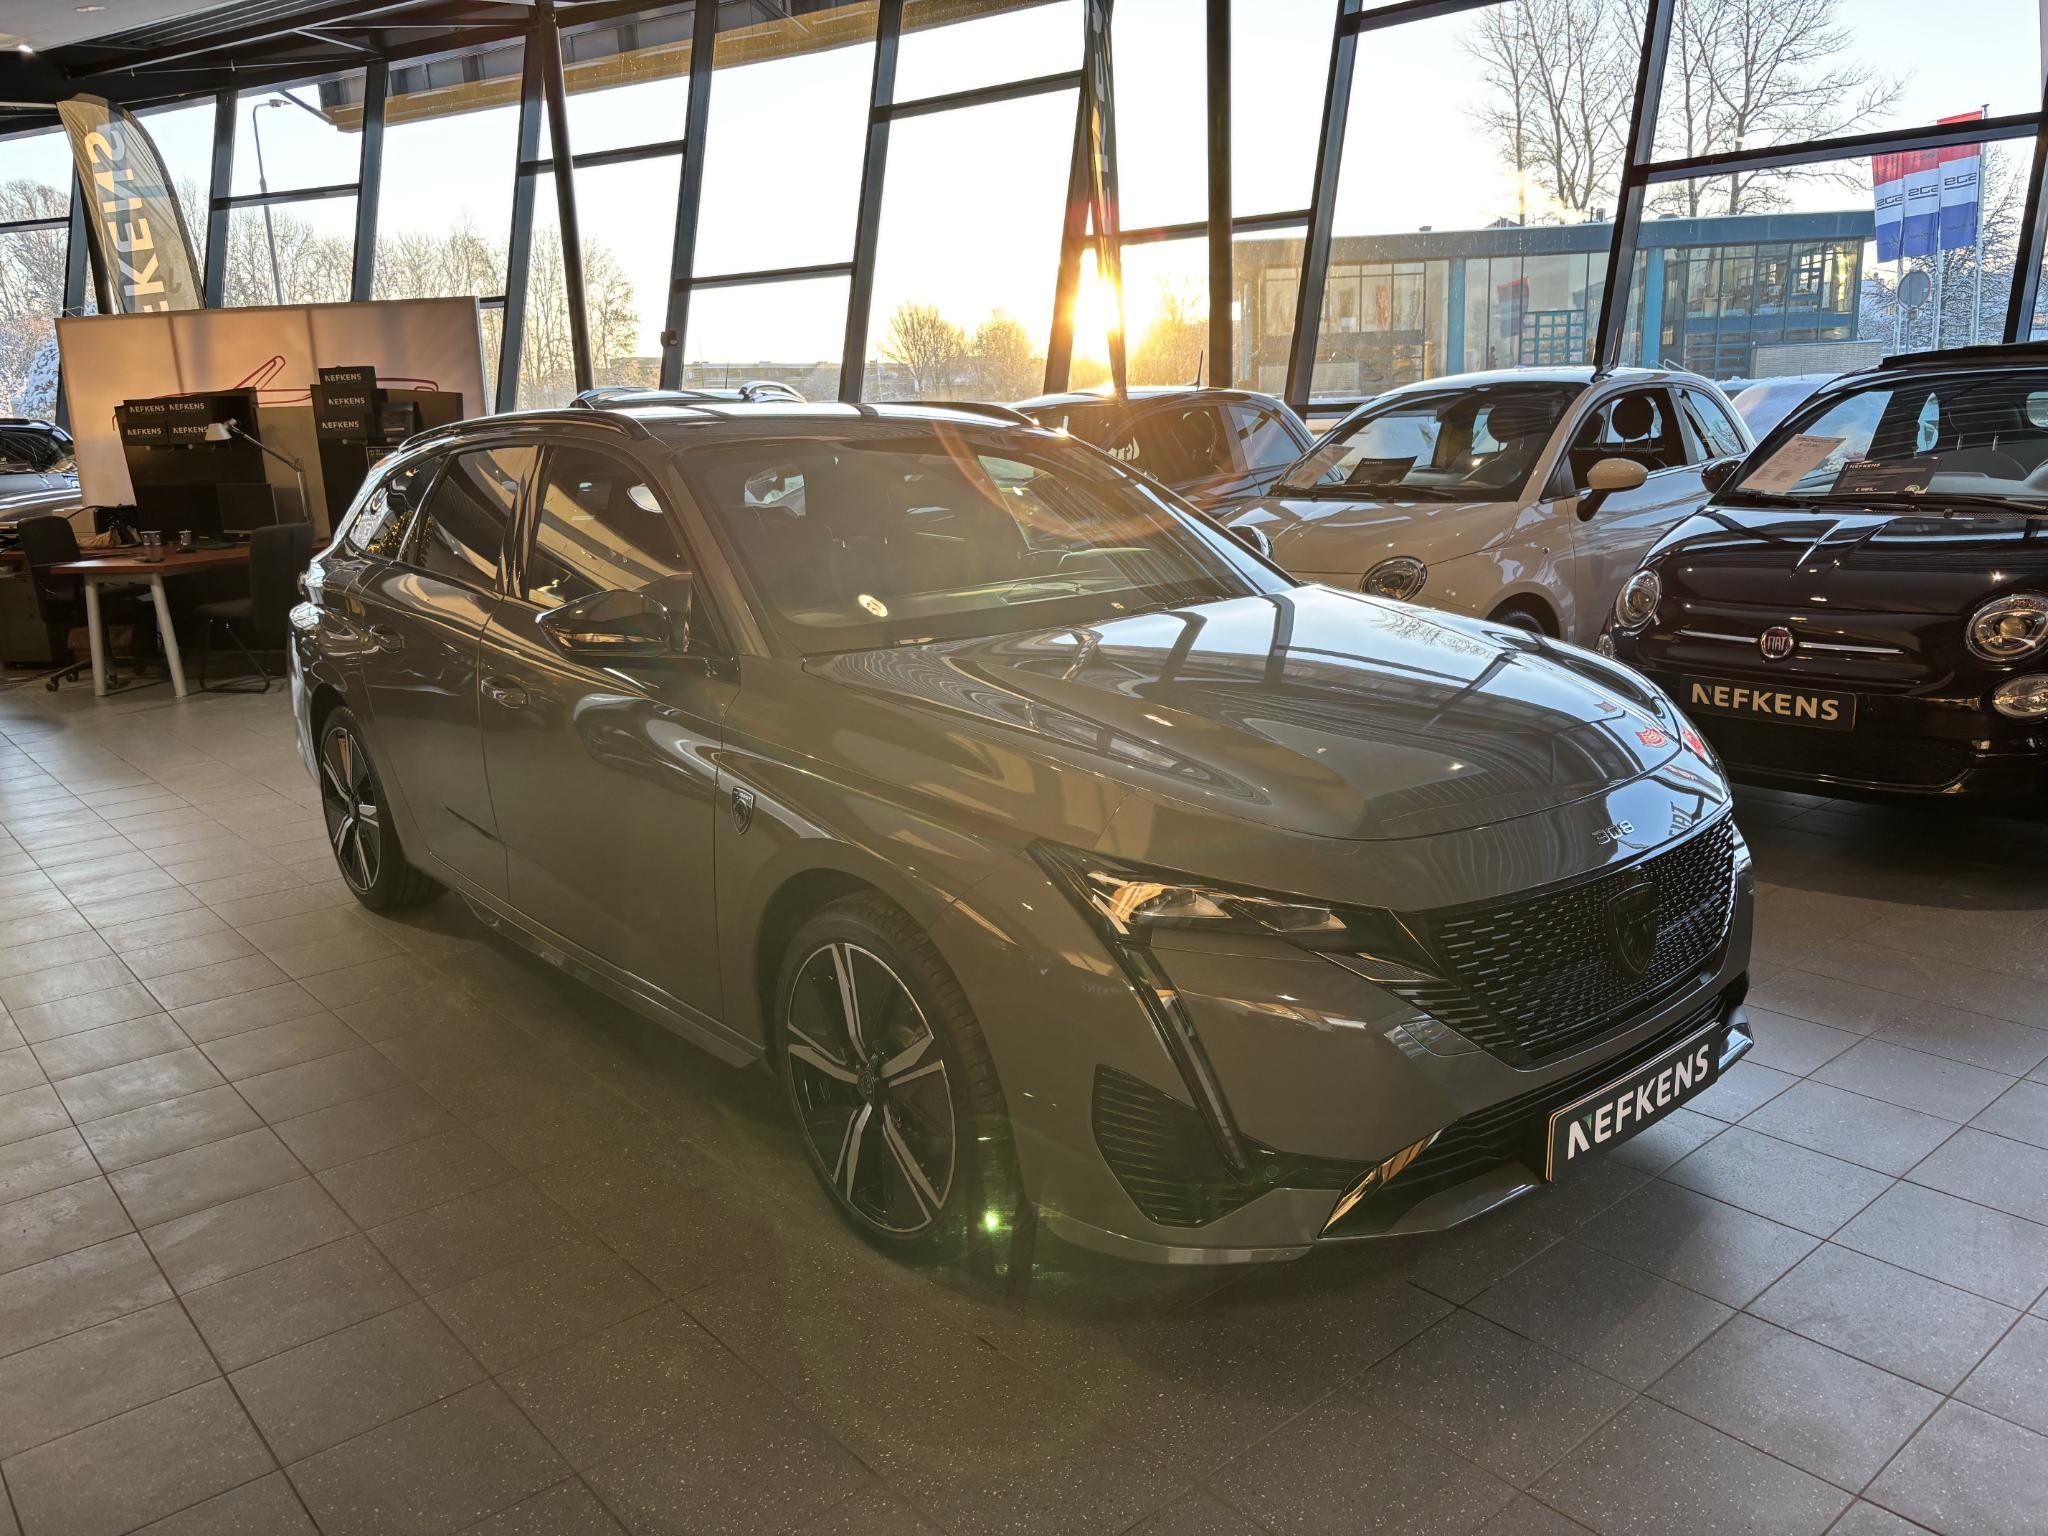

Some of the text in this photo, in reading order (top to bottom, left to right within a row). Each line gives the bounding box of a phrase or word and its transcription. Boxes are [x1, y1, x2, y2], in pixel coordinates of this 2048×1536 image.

[324, 373, 362, 382] NEFKENS
[328, 397, 366, 406] NEFKENS
[129, 404, 166, 413] NEFKENS
[168, 402, 205, 411] NEFKENS
[321, 420, 360, 429] NEFKENS
[127, 427, 162, 436] NEFKENS
[173, 425, 209, 434] NEFKENS
[1767, 635, 1788, 651] FIAT
[1691, 682, 1840, 721] NEFKENS
[1591, 819, 1635, 845] 308
[1567, 1043, 1709, 1160] NEFKENS
